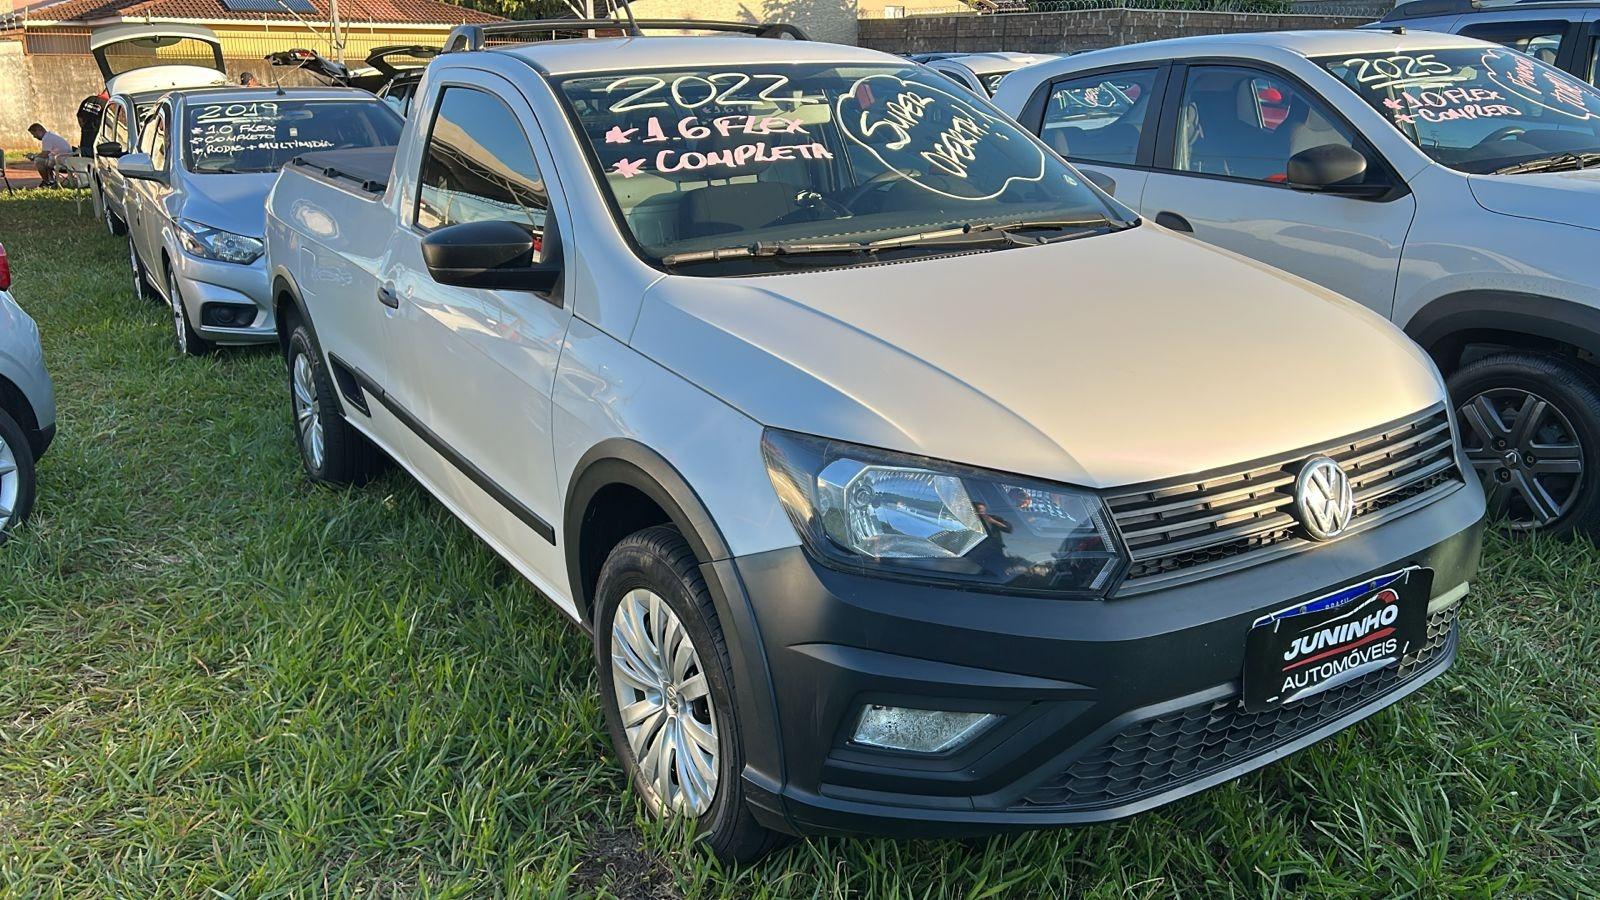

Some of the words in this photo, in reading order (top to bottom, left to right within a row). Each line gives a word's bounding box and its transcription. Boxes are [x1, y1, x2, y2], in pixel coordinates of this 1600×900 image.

[1343, 55, 1451, 82] 2025
[606, 73, 819, 112] 2022
[1444, 87, 1506, 103] FLEX
[197, 103, 278, 119] 2019
[860, 91, 935, 150] SUPER
[1418, 104, 1522, 122] COMPLETO
[204, 133, 275, 144] COMPLETO
[240, 124, 277, 133] FLEX
[643, 116, 711, 143] 1.6
[713, 115, 810, 137] FLEX
[656, 142, 834, 173] COMPLETA
[1284, 604, 1399, 661] JUNINHO
[1281, 638, 1398, 692] AUTOMÓVEIS
